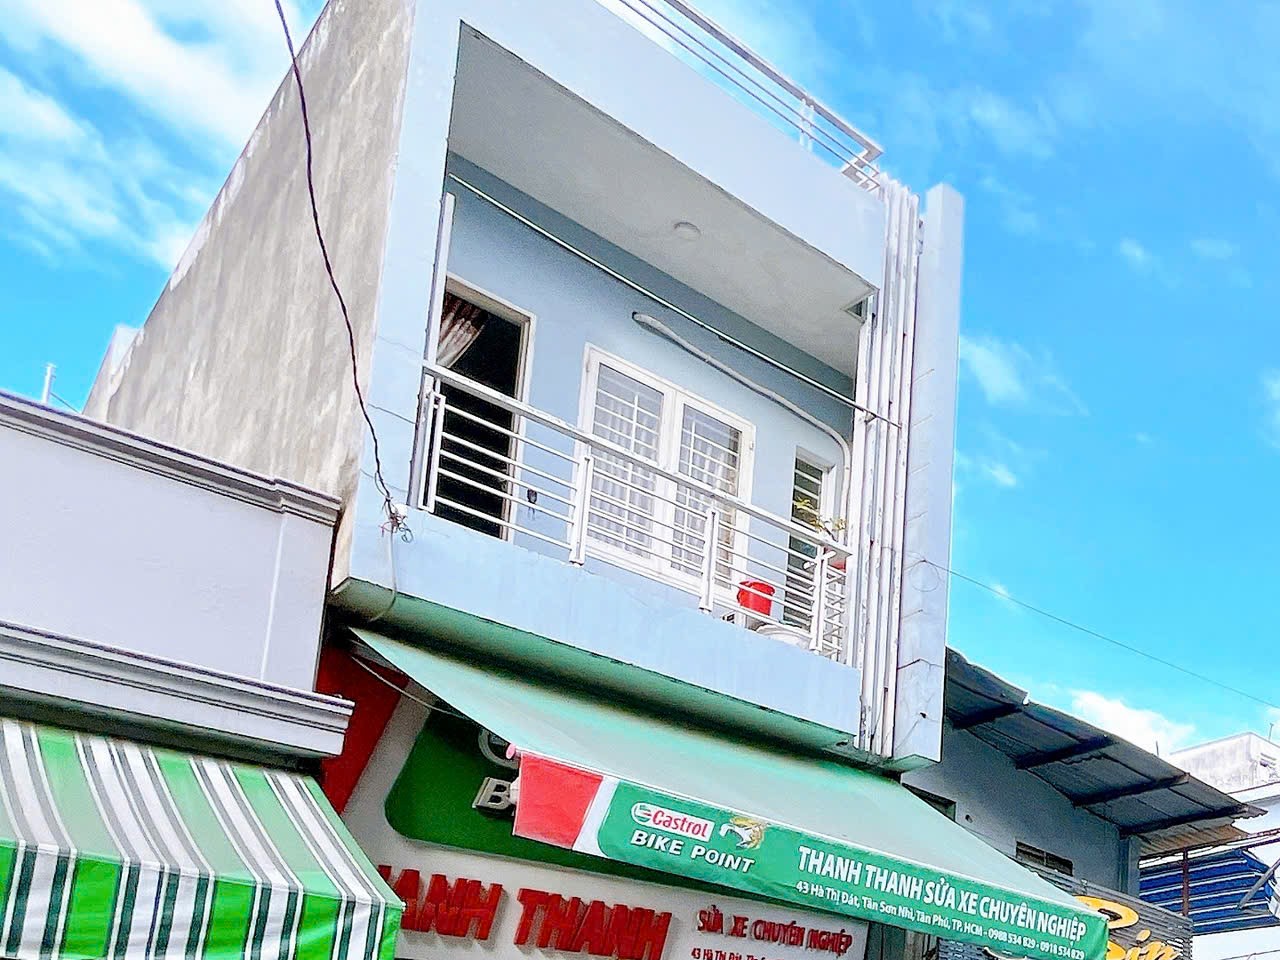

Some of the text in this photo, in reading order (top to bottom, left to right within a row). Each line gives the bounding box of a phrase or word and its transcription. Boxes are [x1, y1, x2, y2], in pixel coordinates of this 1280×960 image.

[652, 810, 708, 838] Castrol
[630, 830, 755, 873] BIKE POINT
[796, 881, 809, 894] 43
[810, 883, 825, 898] Hà
[825, 886, 840, 906] Thị
[862, 895, 879, 911] Tân
[879, 901, 897, 916] Sơn
[915, 910, 931, 924] Tân
[963, 922, 983, 936] HCM
[798, 846, 1087, 946] THANH THANH SỬA XE CHUYÊN NGHIỆP
[728, 915, 749, 938] XE
[691, 948, 700, 960] 43
[702, 948, 713, 960] Hà
